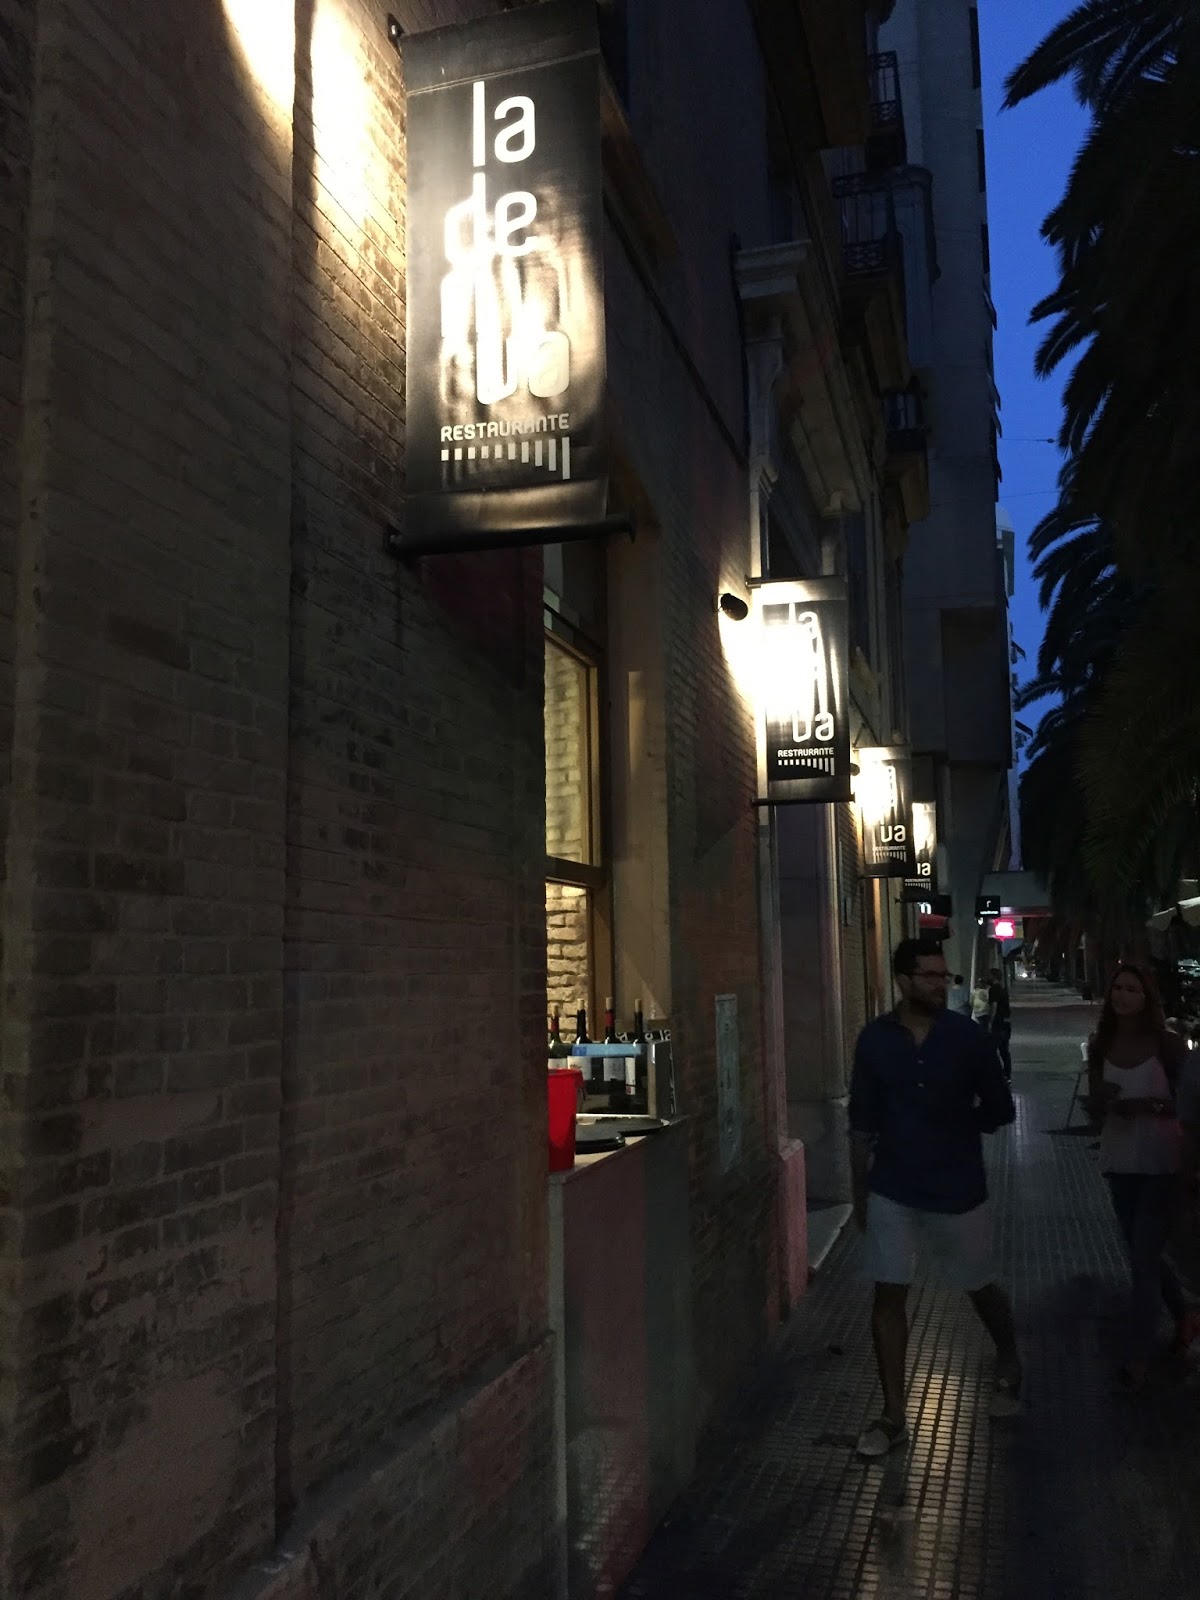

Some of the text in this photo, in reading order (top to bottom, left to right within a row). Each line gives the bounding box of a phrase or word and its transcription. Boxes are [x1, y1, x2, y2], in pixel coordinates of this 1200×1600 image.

[472, 80, 536, 167] la
[443, 172, 538, 258] de
[440, 412, 570, 443] RESTAURANTE
[777, 747, 834, 758] RESTAURANTE
[880, 824, 906, 843] ua
